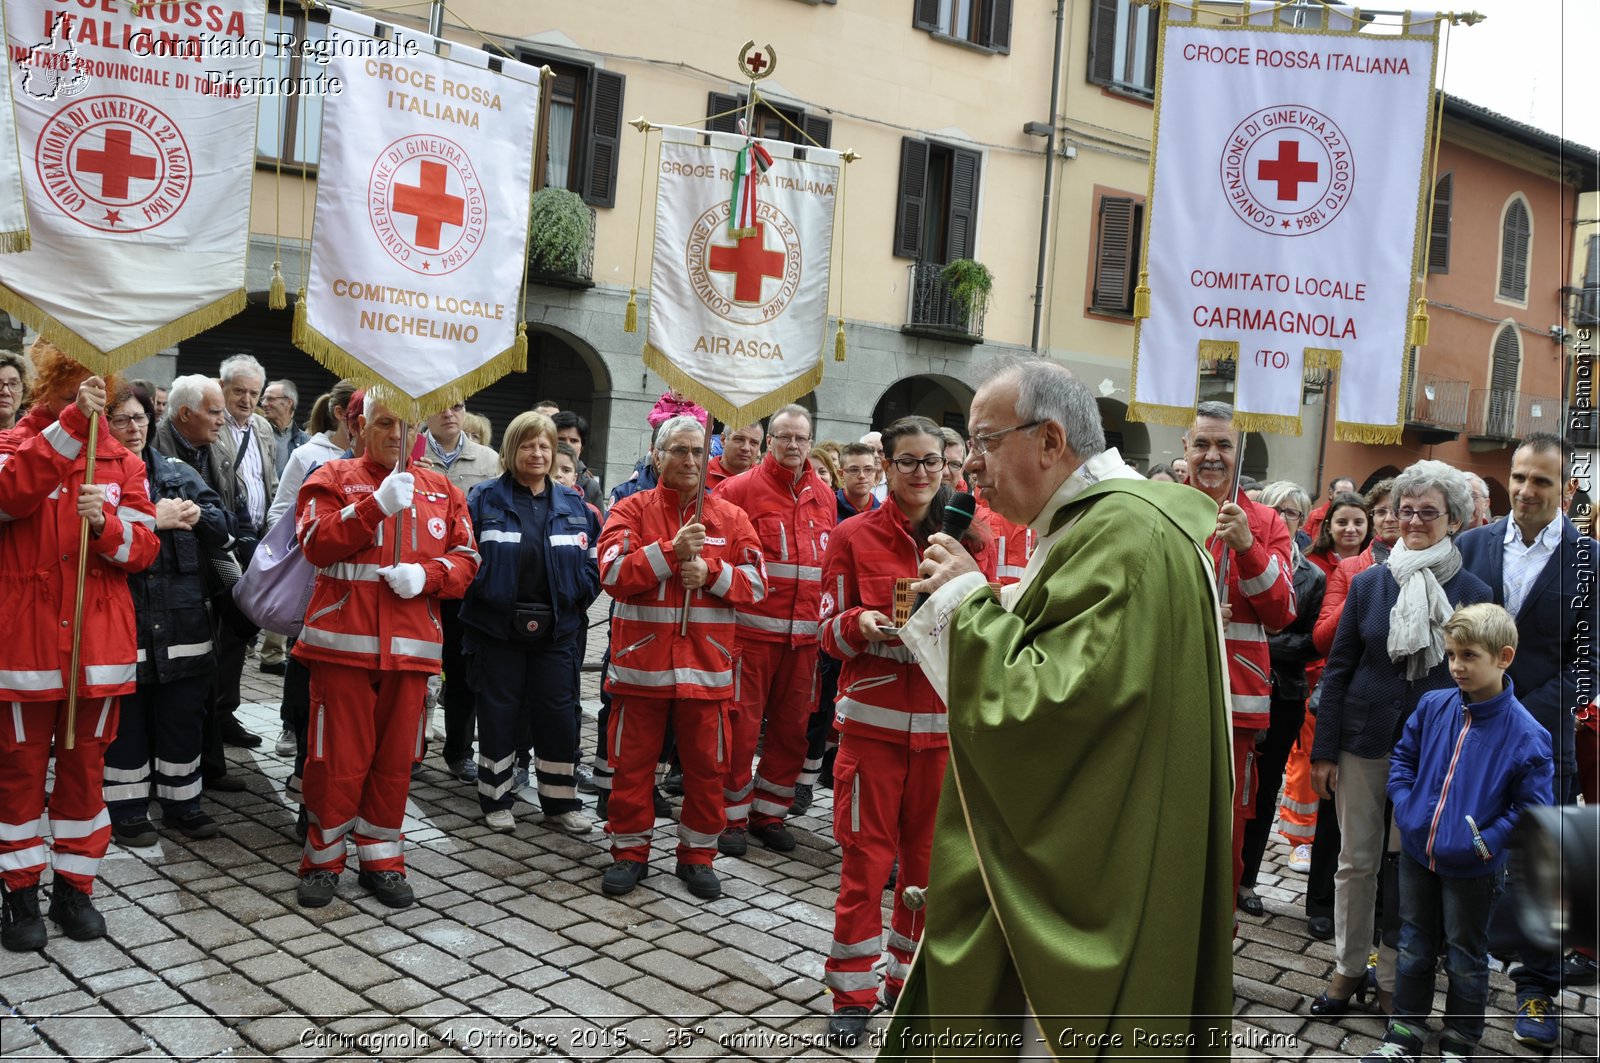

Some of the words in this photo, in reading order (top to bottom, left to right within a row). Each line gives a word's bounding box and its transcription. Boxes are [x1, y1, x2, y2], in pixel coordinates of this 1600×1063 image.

[44, 9, 203, 63] ITALIANA
[75, 57, 170, 87] PROVINCIALE
[175, 72, 189, 90] DI
[1183, 43, 1250, 65] CROCE
[1256, 48, 1320, 69] ROSSA
[1327, 53, 1410, 75] ITALIANA
[364, 58, 436, 92] CROCE
[442, 79, 503, 112] ROSSA
[67, 107, 90, 127] DI
[91, 101, 158, 130] GINEVRA
[387, 90, 480, 130] ITALIANA
[1262, 110, 1326, 135] GINEVRA
[154, 125, 177, 143] 22
[1244, 120, 1261, 137] DI
[1324, 131, 1341, 149] 22
[43, 121, 86, 212] CONVENZIONE
[388, 147, 404, 164] DI
[405, 140, 461, 165] GINEVRA
[164, 147, 187, 199] AGOSTO
[460, 164, 472, 183] 22
[661, 160, 715, 178] CROCE
[775, 175, 834, 196] ITALIANA
[1226, 135, 1275, 227] CONVENZIONE
[1325, 150, 1349, 210] AGOSTO
[142, 195, 174, 222] 1864
[373, 162, 411, 261] CONVENZIONE
[466, 186, 482, 244] AGOSTO
[704, 210, 720, 227] DI
[1296, 208, 1326, 230] 1864
[779, 220, 794, 238] 22
[441, 245, 468, 269] 1864
[689, 223, 731, 315] CONVENZIONE
[783, 241, 800, 298] AGOSTO
[332, 278, 430, 309] COMITATO
[435, 295, 505, 321] LOCALE
[1190, 269, 1290, 293] COMITATO
[1295, 278, 1366, 301] LOCALE
[762, 298, 784, 319] 1864
[1193, 305, 1357, 339] CARMAGNOLA
[359, 311, 479, 344] NICHELINO
[693, 335, 784, 361] AIRASCA
[1255, 349, 1290, 370] (TO)
